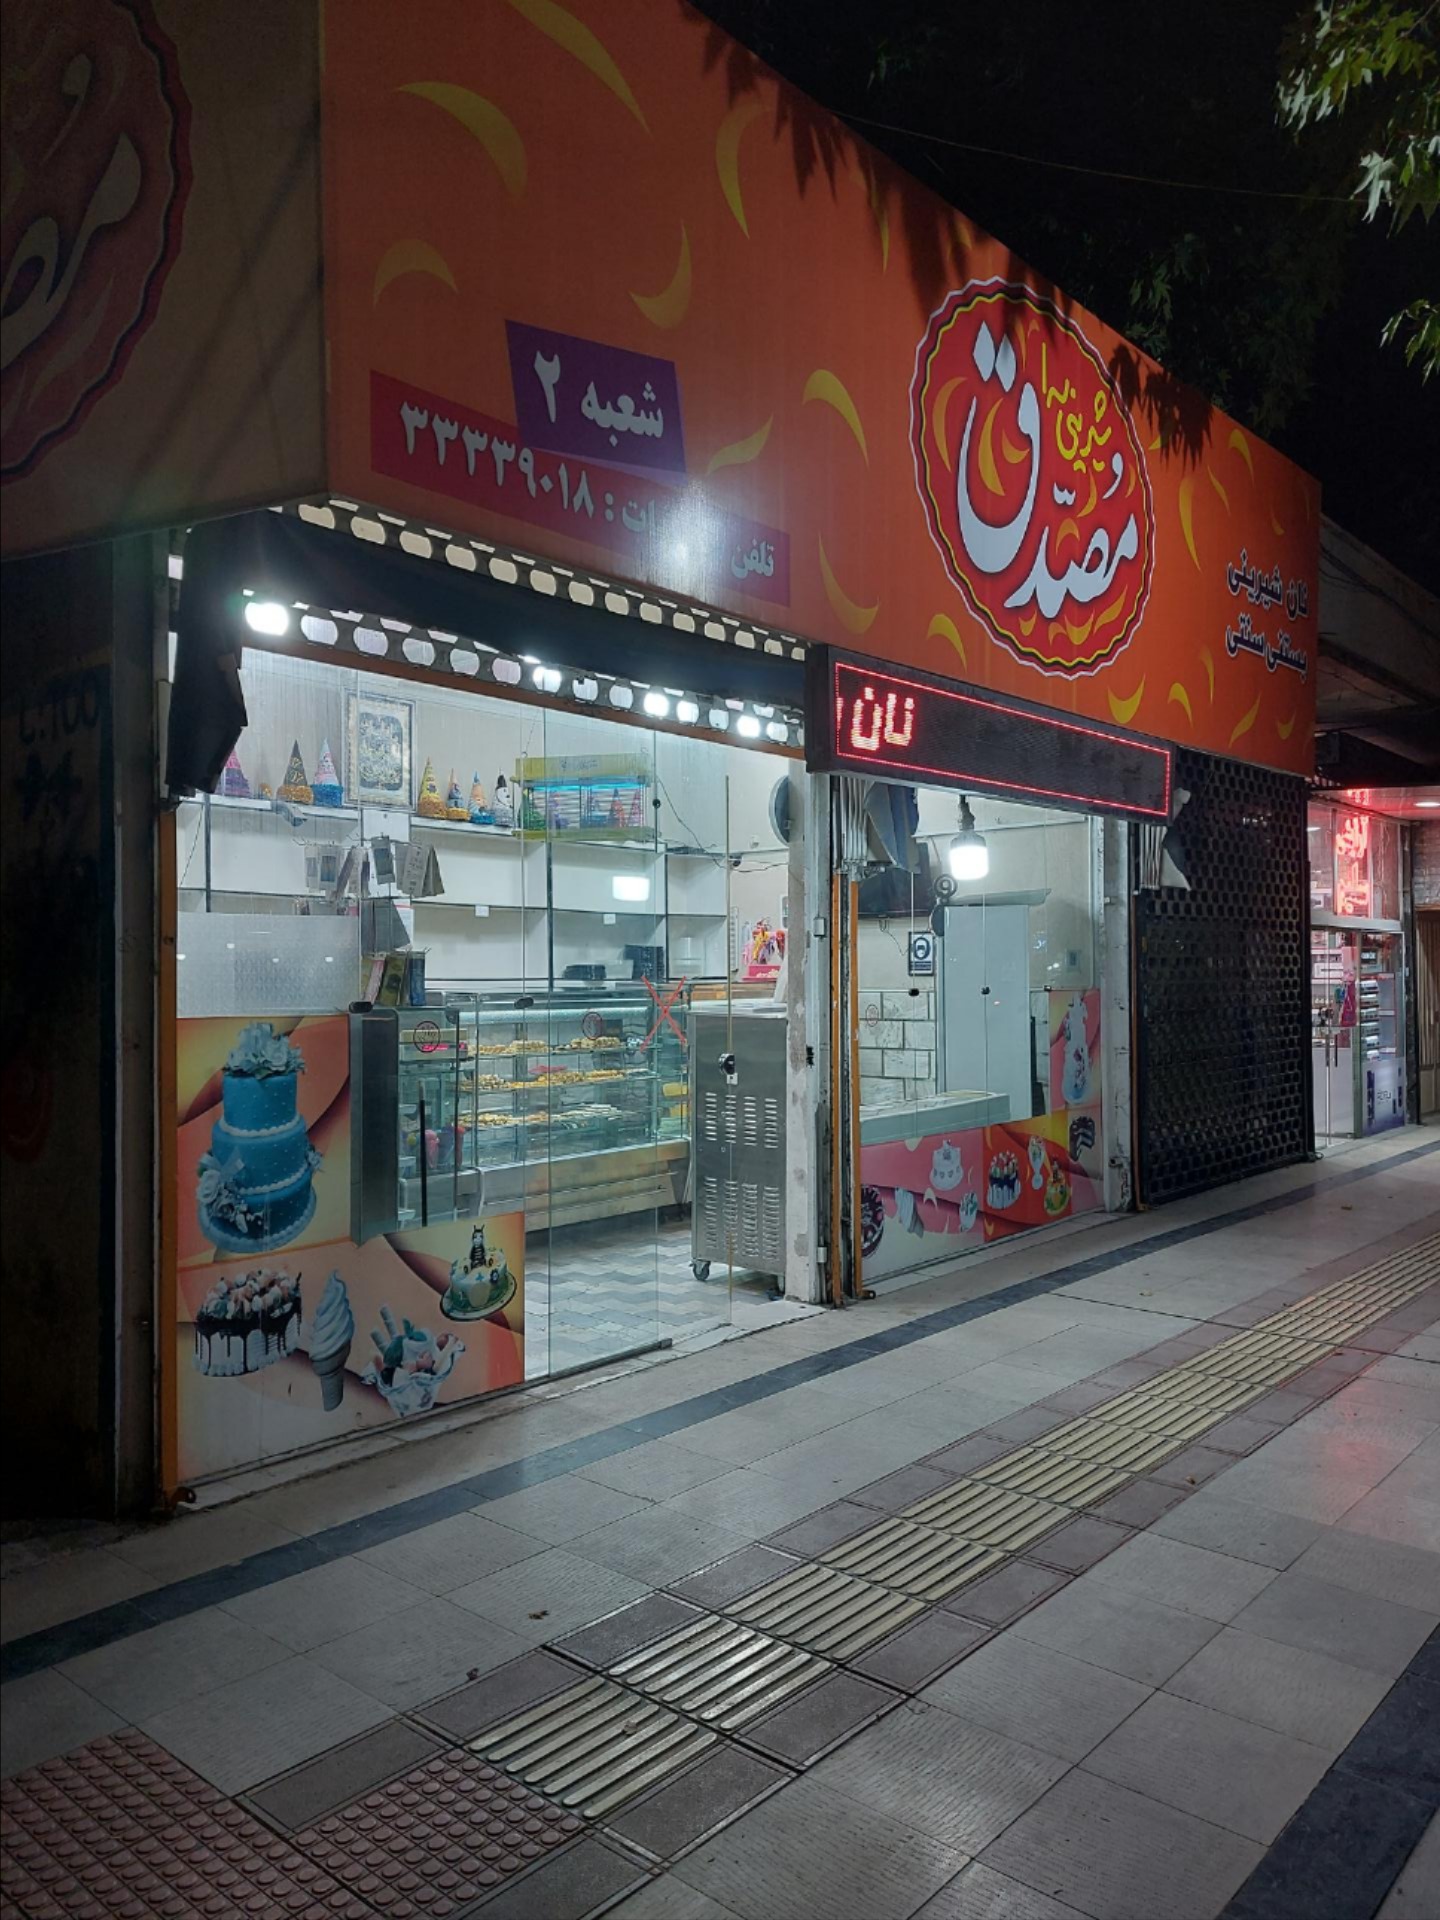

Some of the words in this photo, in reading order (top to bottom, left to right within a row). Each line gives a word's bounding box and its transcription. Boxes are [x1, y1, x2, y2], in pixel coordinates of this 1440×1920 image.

[533, 350, 561, 424] ۲
[580, 381, 664, 447] شعبه
[400, 400, 595, 519] ۳۳۳۳۹۰۱۸
[730, 541, 775, 580] تلفن
[1226, 547, 1283, 610] شیرینی
[1286, 578, 1308, 621] نان
[1225, 612, 1266, 658] سنتی
[1265, 628, 1307, 684] بستنی
[850, 686, 914, 751] نان
